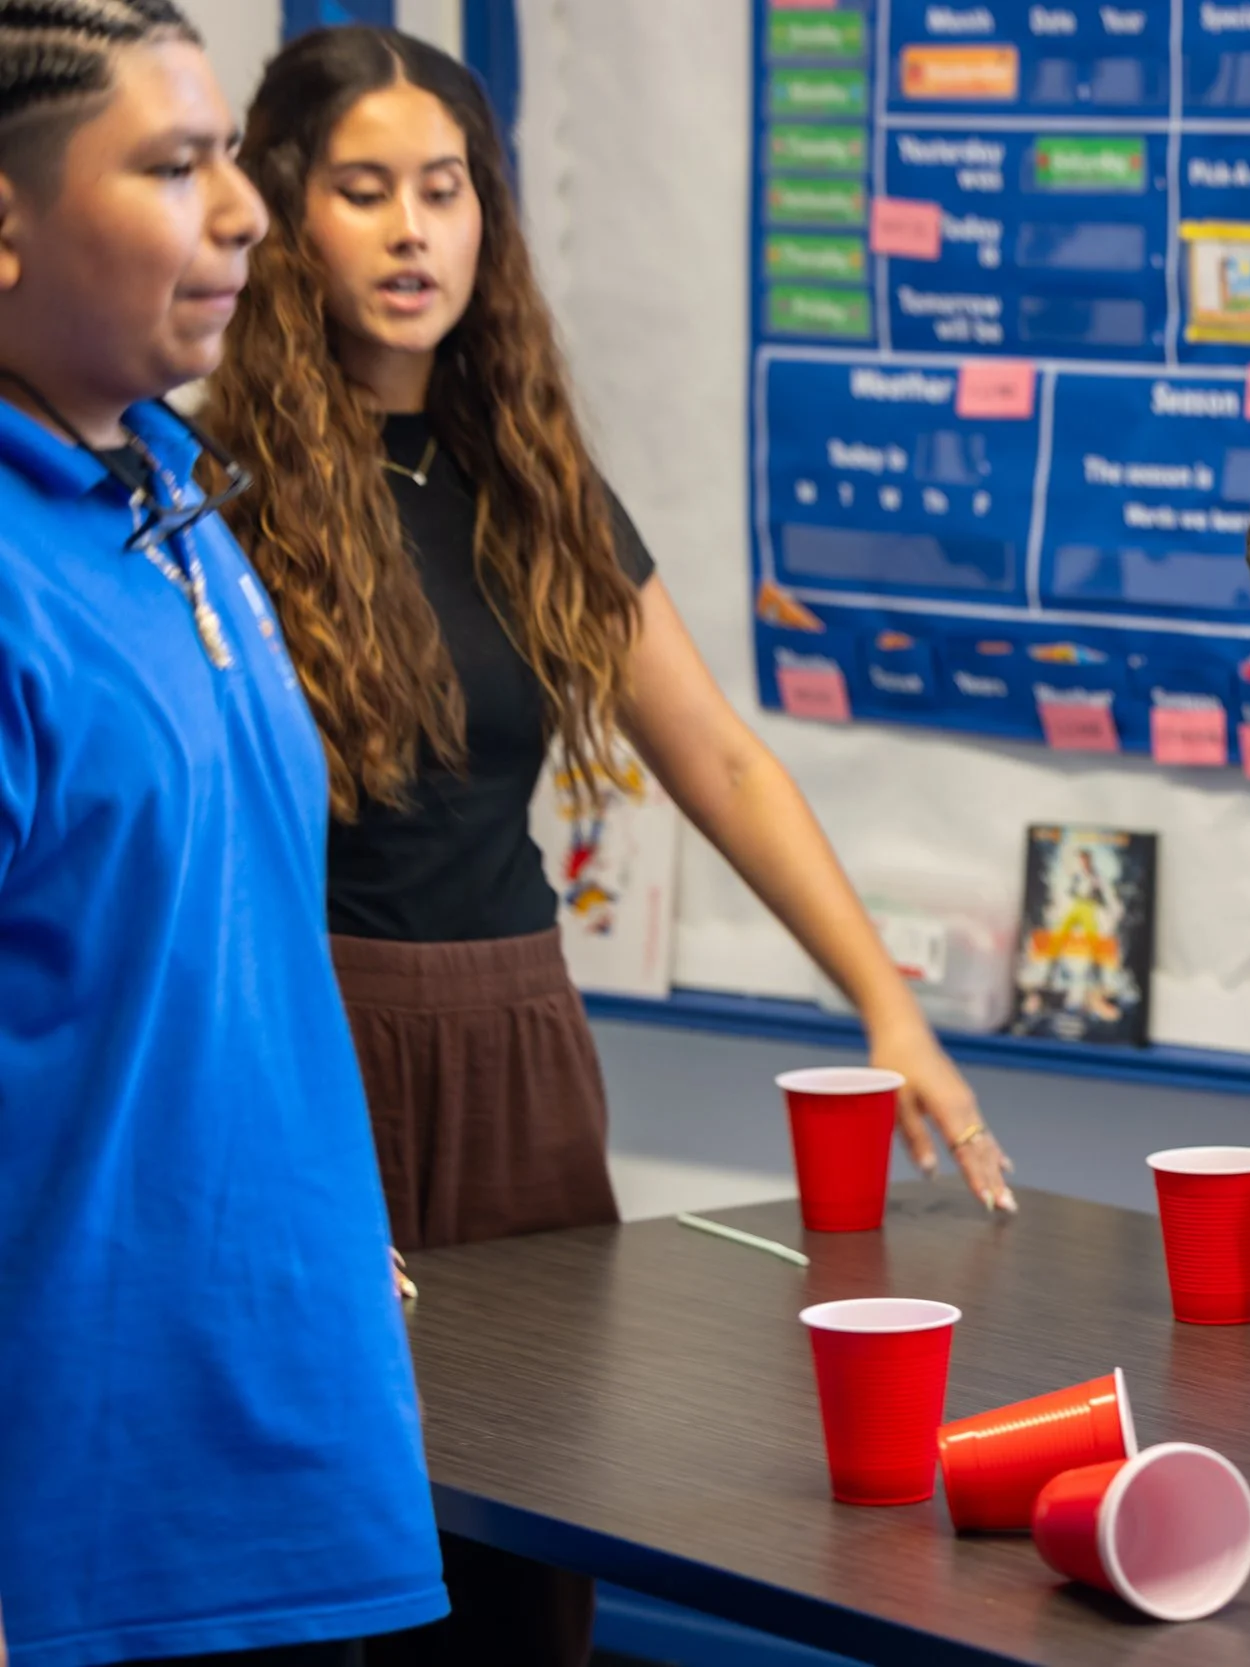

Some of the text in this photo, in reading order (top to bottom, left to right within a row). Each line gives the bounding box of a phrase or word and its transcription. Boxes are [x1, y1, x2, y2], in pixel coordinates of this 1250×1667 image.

[926, 5, 995, 34] Month
[1029, 5, 1077, 35] Date
[1100, 5, 1146, 34] Year
[897, 135, 1004, 168] Yesterday
[957, 168, 1003, 191] was
[940, 209, 1002, 243] Today
[898, 286, 1001, 317] Tomorrow
[850, 368, 955, 404] Weather
[1152, 381, 1240, 418] Season
[826, 437, 884, 475] Today
[1084, 455, 1122, 486] The
[1124, 463, 1190, 489] season
